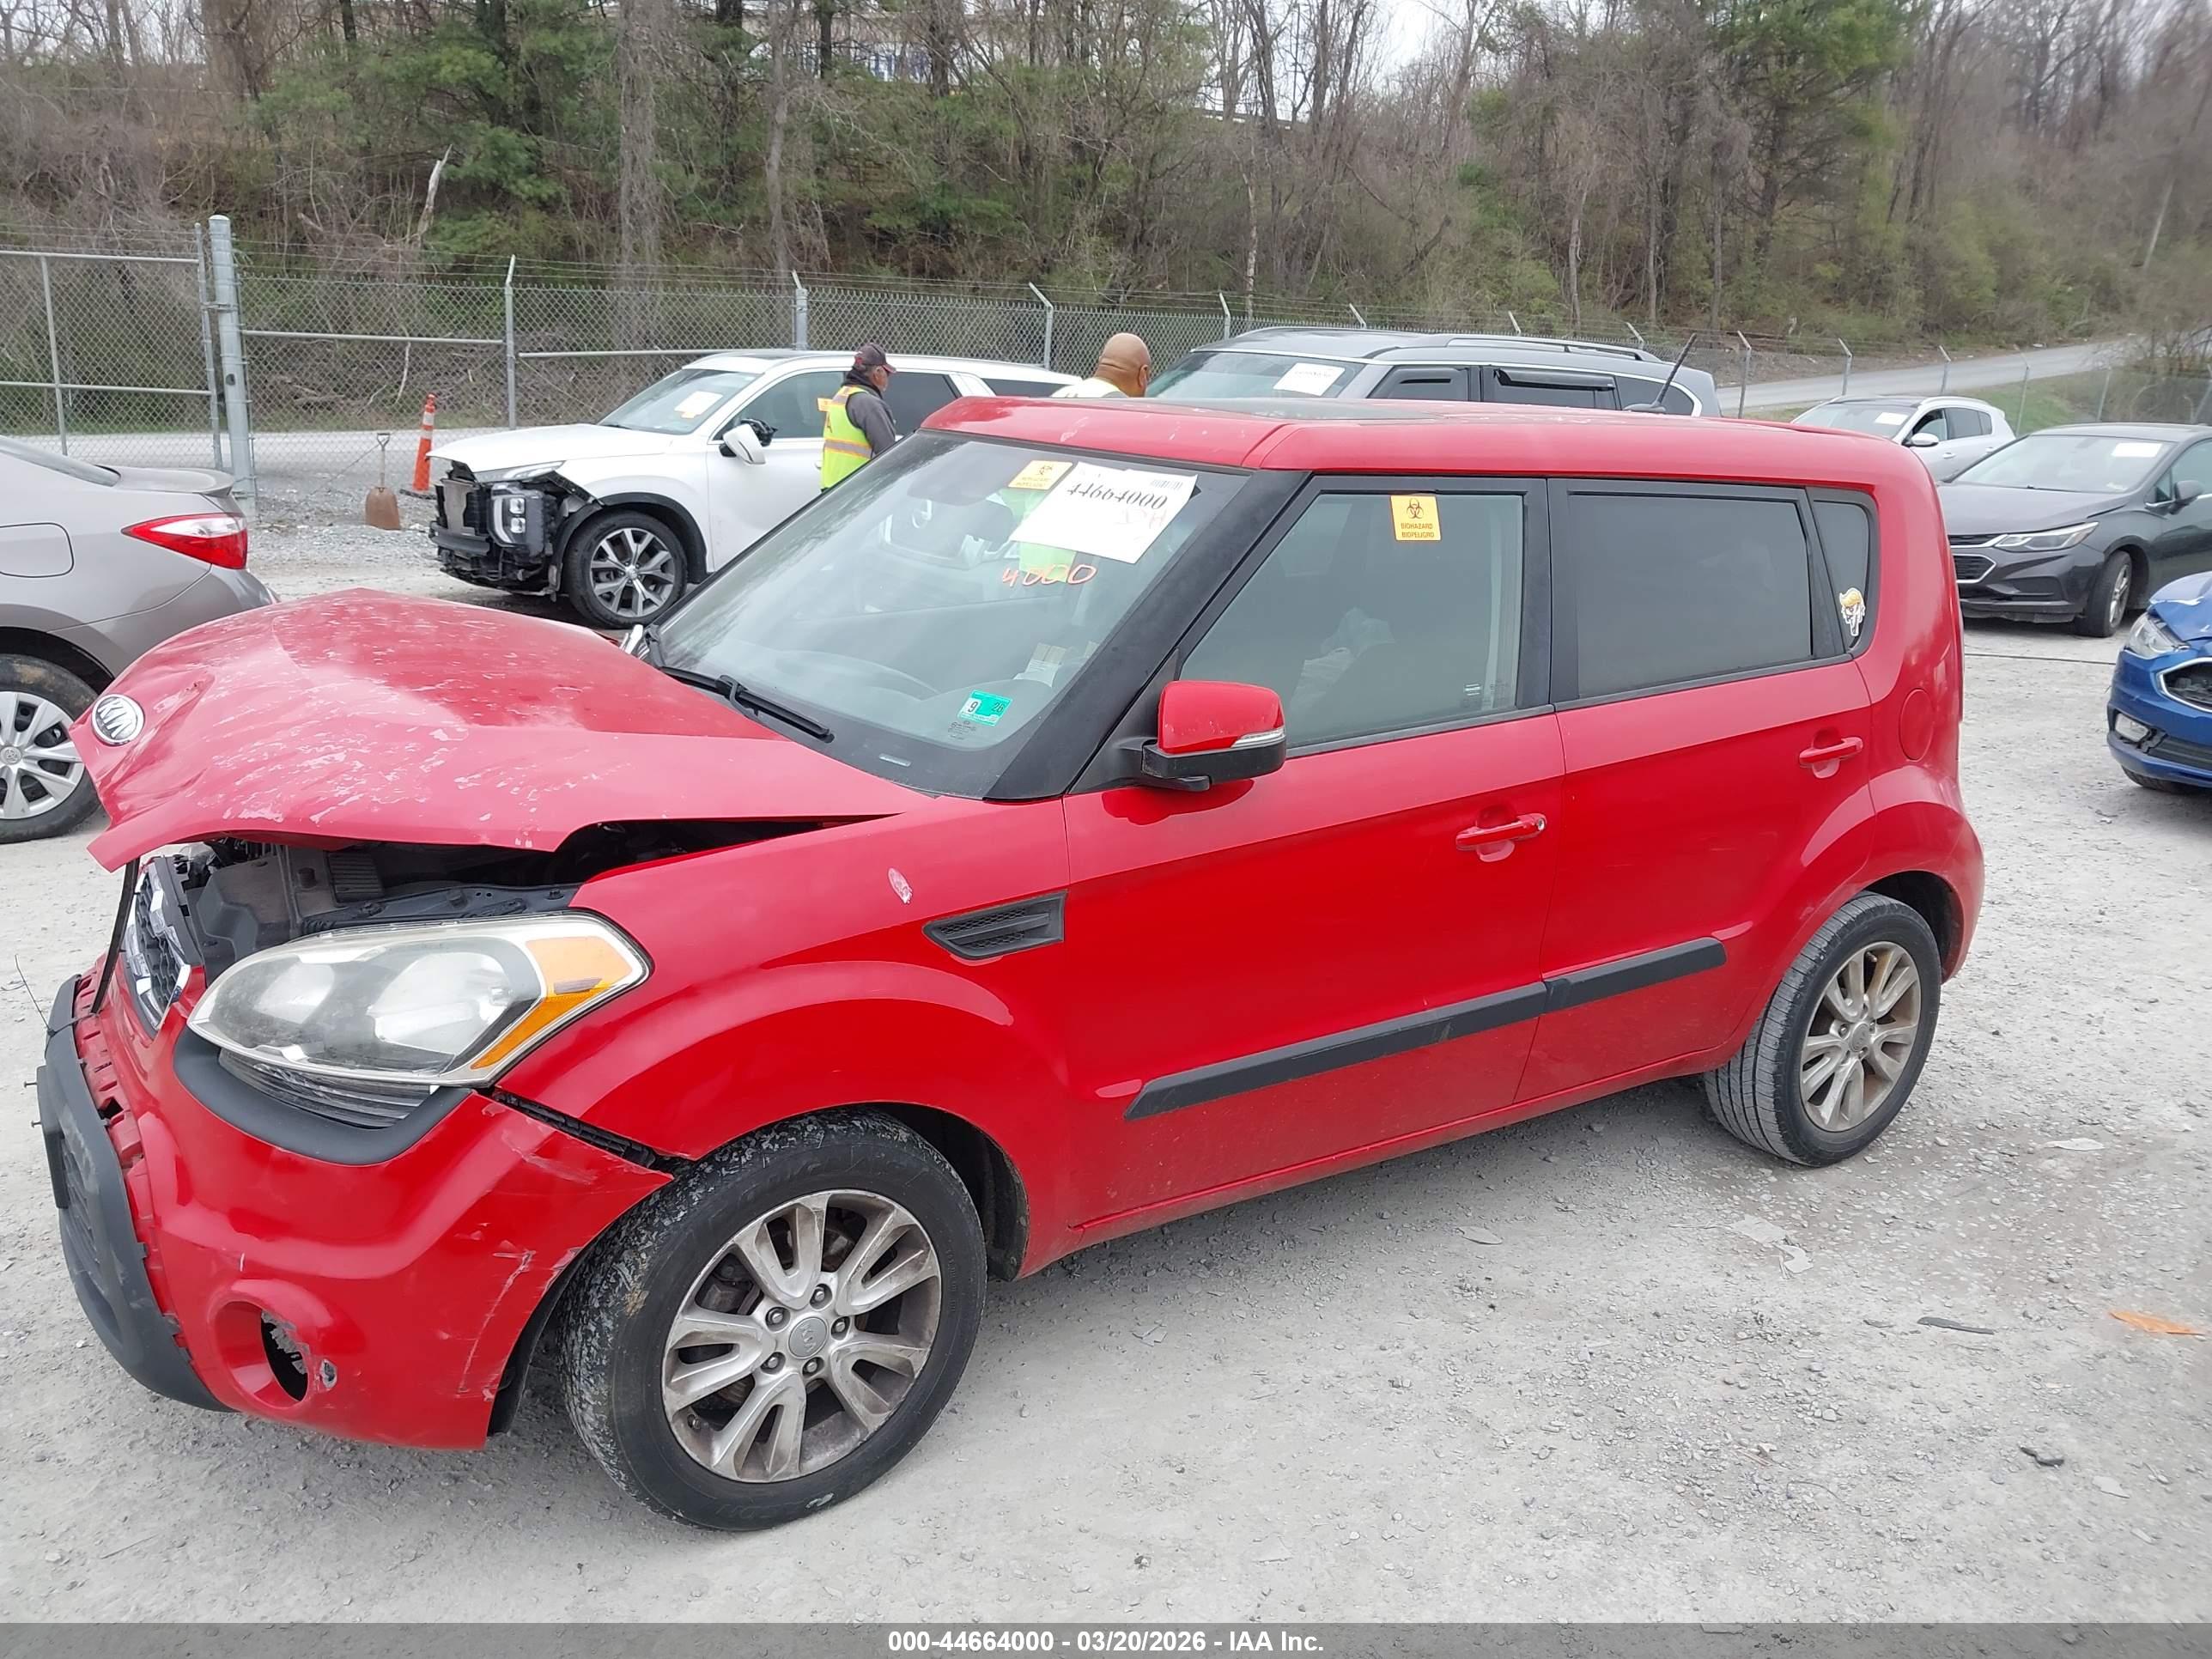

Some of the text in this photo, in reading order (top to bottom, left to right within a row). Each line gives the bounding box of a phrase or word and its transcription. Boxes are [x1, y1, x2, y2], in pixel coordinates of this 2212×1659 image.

[1067, 483, 1168, 510] 44664000
[967, 701, 979, 713] 9
[991, 702, 1005, 714] 26
[97, 697, 134, 738] KIA
